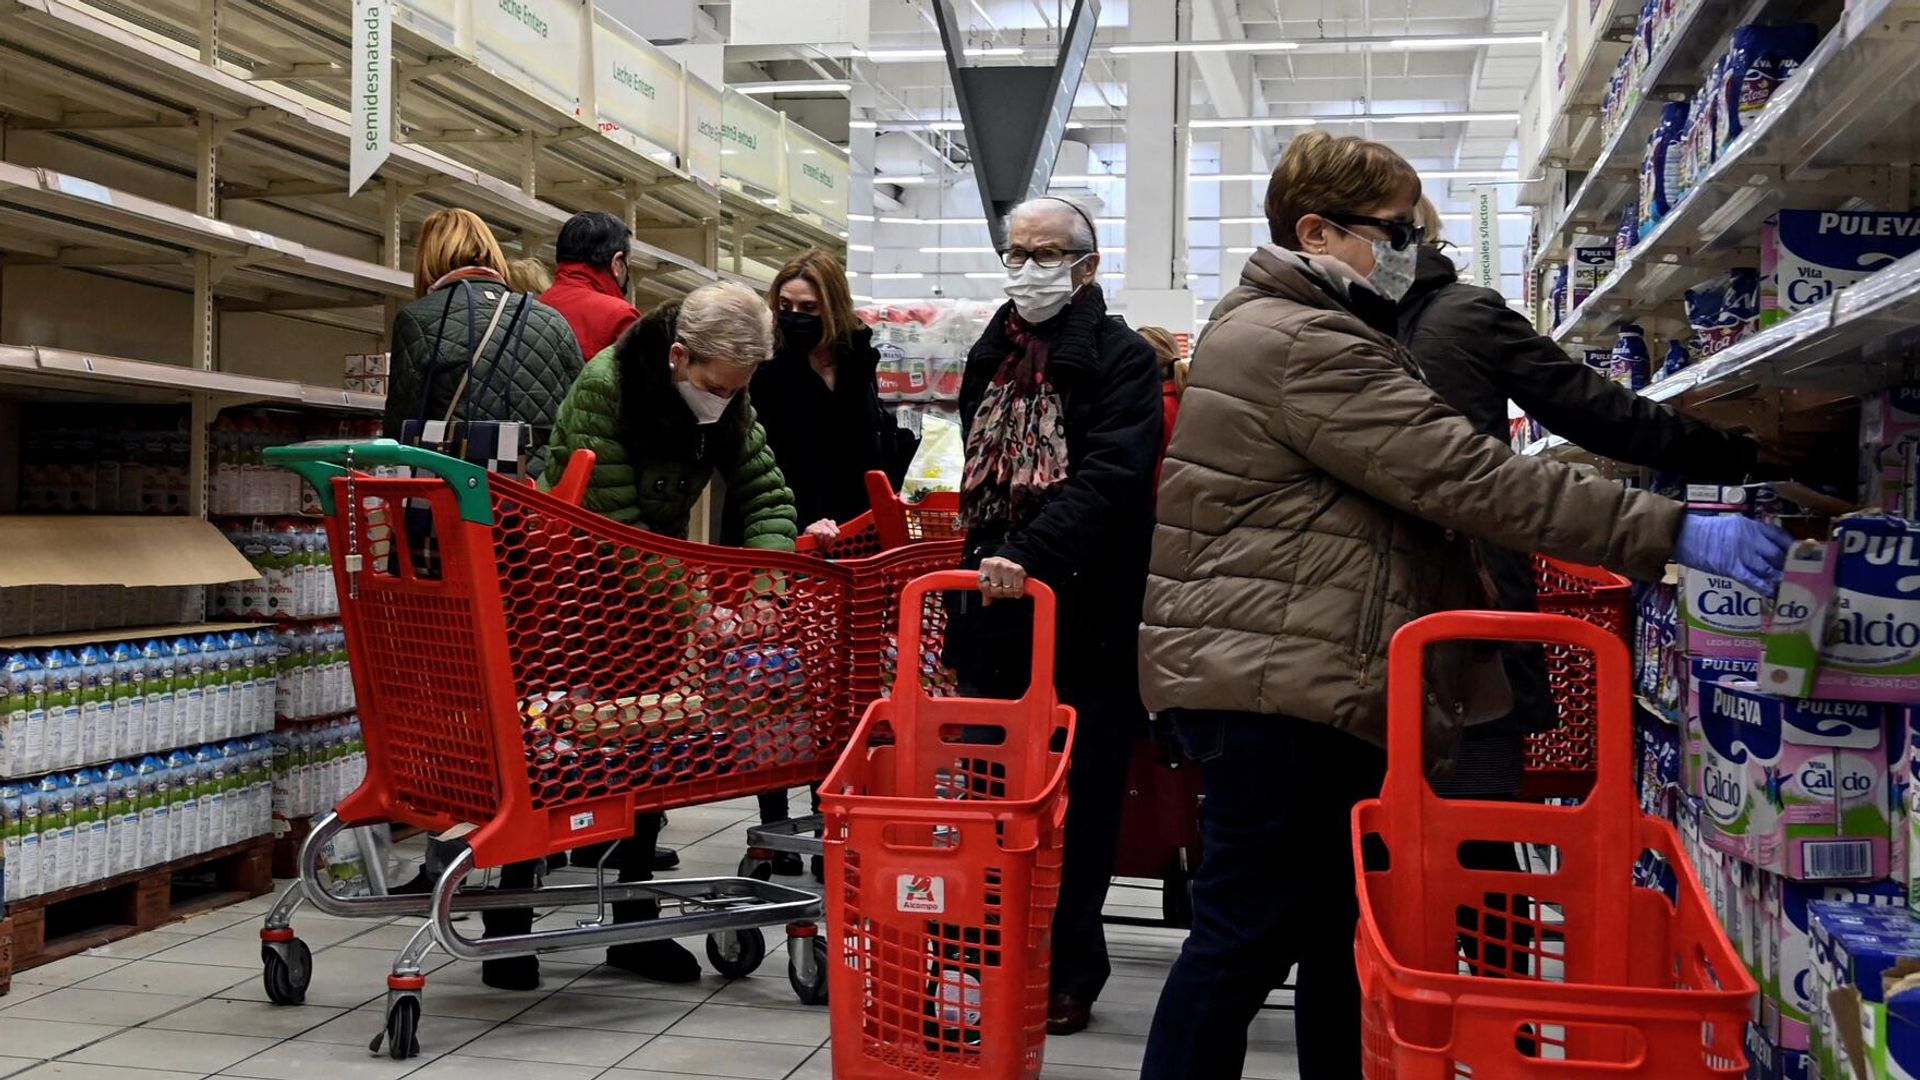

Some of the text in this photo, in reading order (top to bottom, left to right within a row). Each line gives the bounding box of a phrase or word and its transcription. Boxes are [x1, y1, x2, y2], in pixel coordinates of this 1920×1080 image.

[523, 3, 548, 38] Entera
[363, 7, 379, 152] semidesnatada
[612, 61, 655, 100] Leche Entera
[1479, 194, 1489, 237] s/lactosa
[1819, 212, 1920, 237] PULEVA
[1581, 249, 1612, 257] PULEVA
[1798, 267, 1822, 278] Vita
[1707, 578, 1732, 589] Vita
[1702, 658, 1757, 672] PULEVA
[1713, 688, 1762, 726] PULEVA
[1797, 700, 1868, 717] PULEVA
[1704, 767, 1741, 807] Calcio
[904, 901, 938, 910] Alcampo
